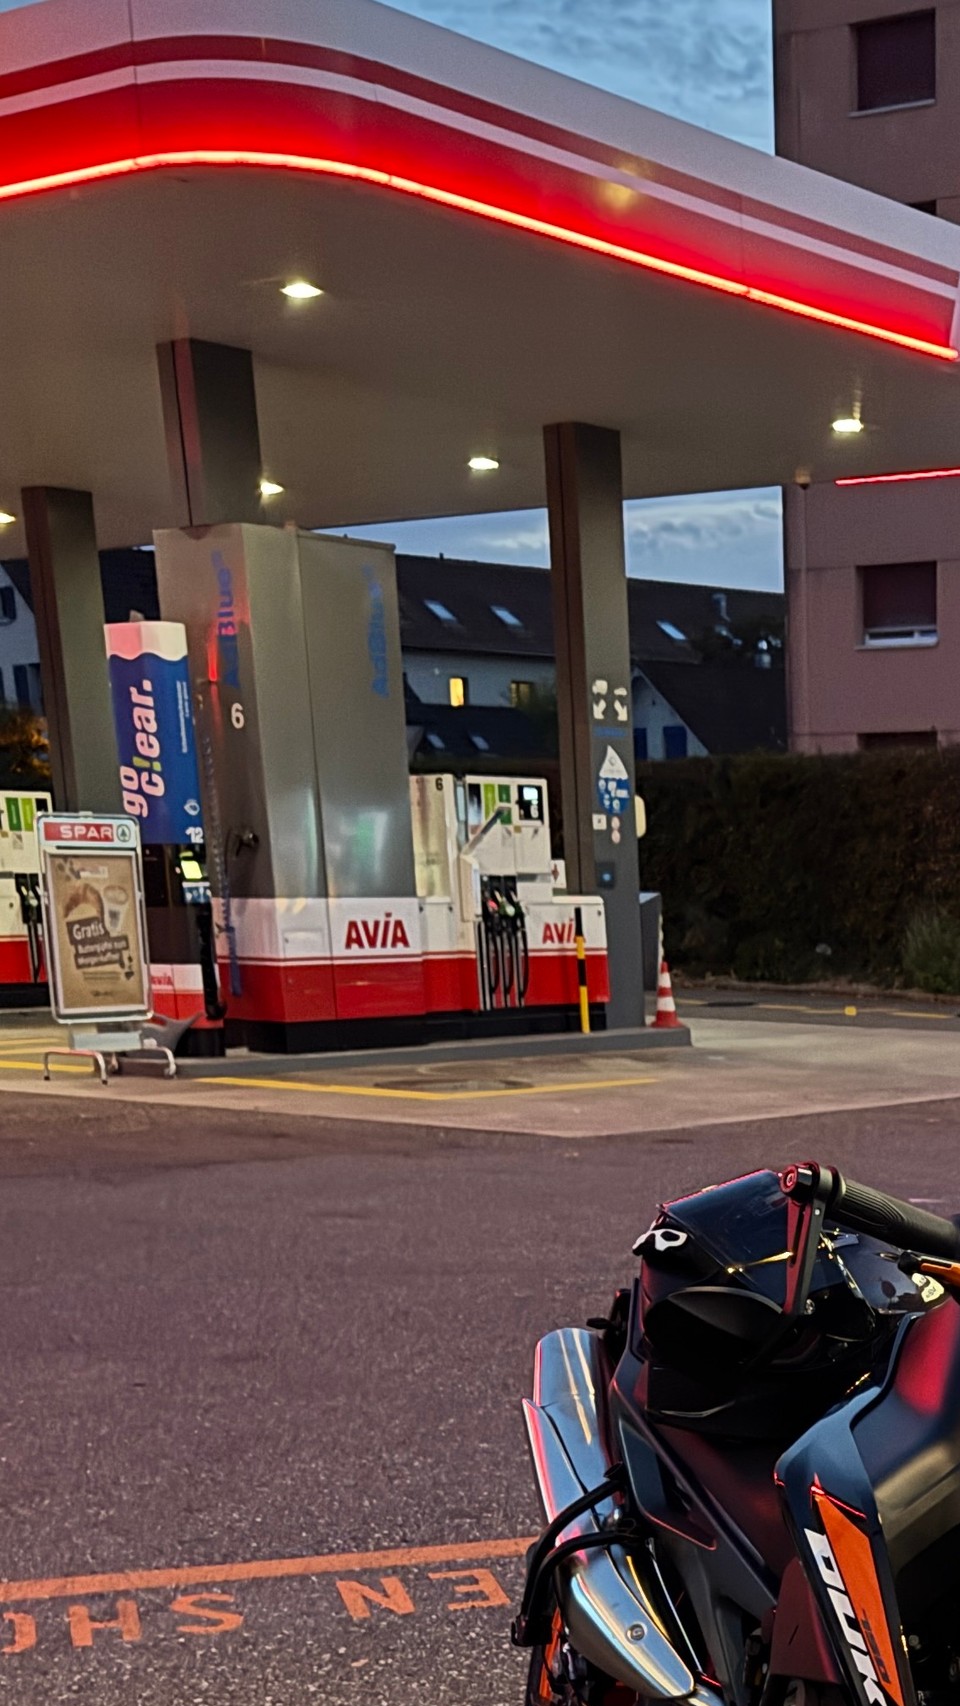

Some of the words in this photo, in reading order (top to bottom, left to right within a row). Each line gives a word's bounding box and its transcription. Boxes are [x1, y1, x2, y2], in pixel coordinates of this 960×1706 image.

[230, 702, 246, 730] 6
[119, 765, 149, 818] go
[435, 776, 444, 792] 6
[59, 824, 114, 840] SPAR
[185, 826, 205, 844] 12
[72, 920, 105, 941] Gratis
